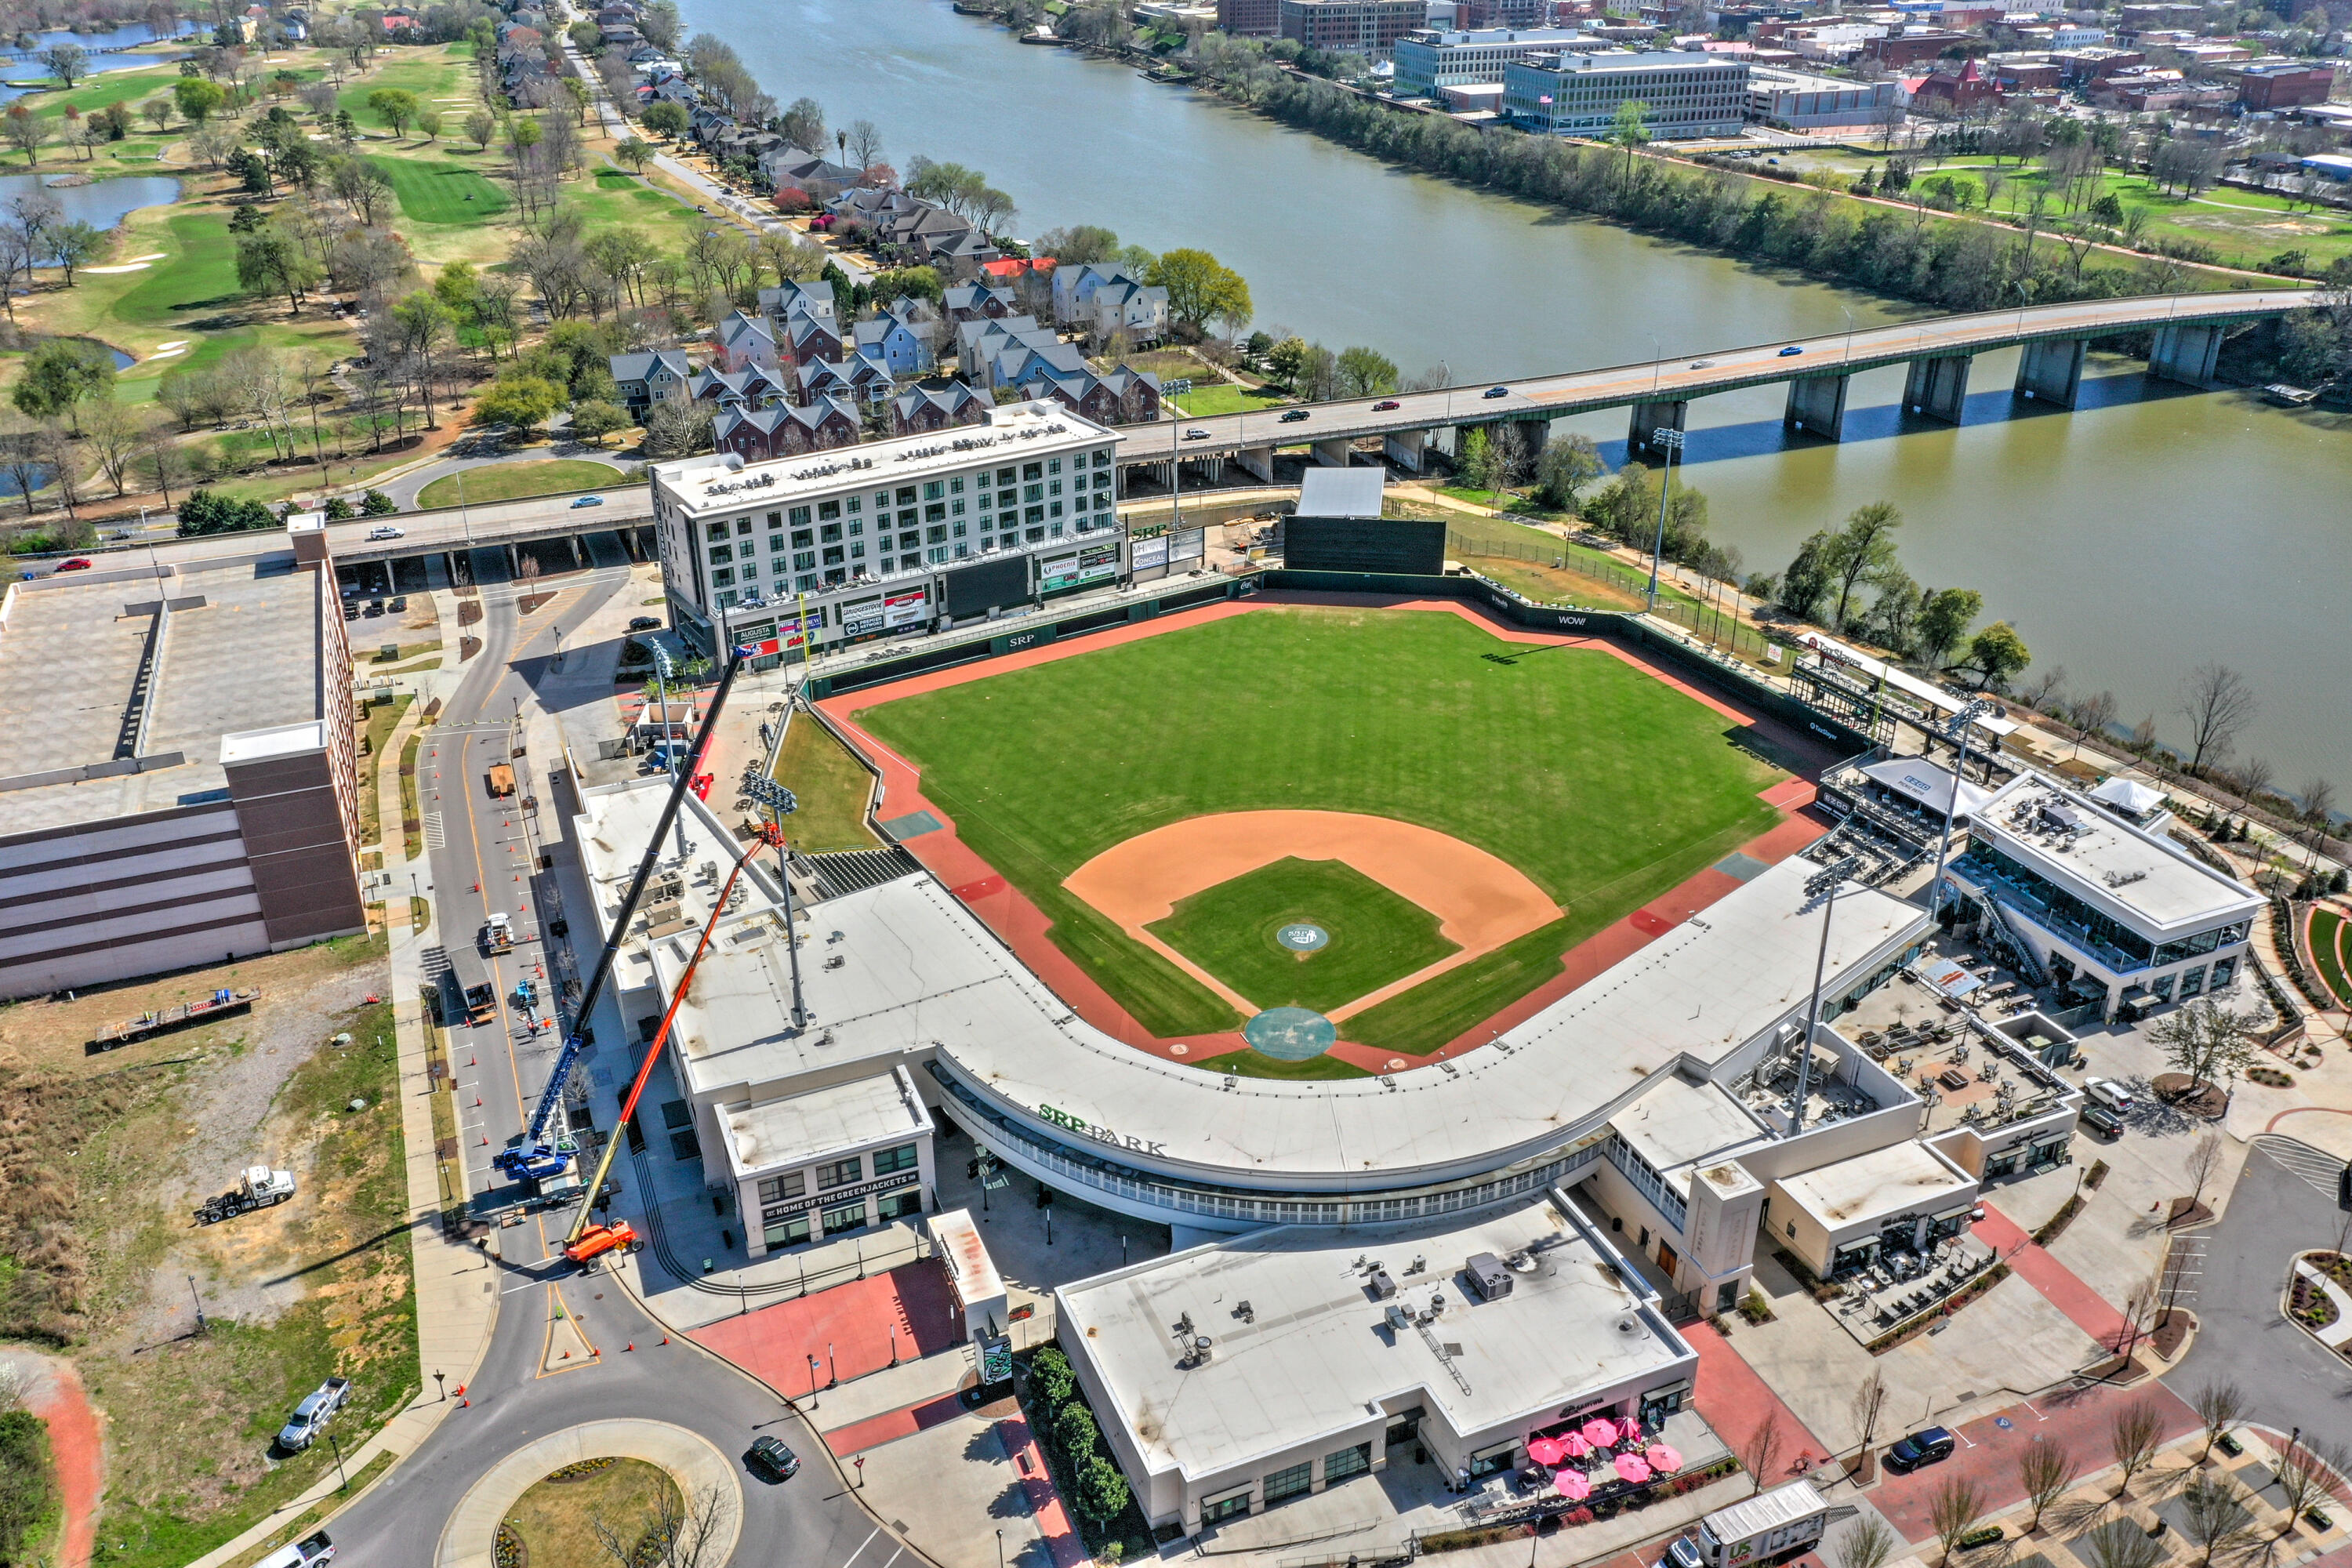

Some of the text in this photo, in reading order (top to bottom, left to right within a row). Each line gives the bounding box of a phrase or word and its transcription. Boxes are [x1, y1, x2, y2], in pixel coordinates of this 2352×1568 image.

[1132, 524, 1167, 541] SRP
[1051, 561, 1076, 571] PHOENIX
[1134, 554, 1165, 568] CONCEAL
[843, 602, 882, 615] BRIDGESTONE
[859, 616, 882, 626] PREMIER
[1559, 615, 1586, 625] WOW!
[740, 627, 771, 638] AUGUSTA
[1010, 634, 1035, 647] SRP
[1819, 641, 1864, 669] TaxSlayer
[1815, 724, 1838, 740] TaxSlayer
[1824, 793, 1849, 812] EZGO
[1039, 1103, 1168, 1159] SRP PARK
[776, 1203, 804, 1216] HOME
[805, 1200, 815, 1208] OF
[818, 1194, 837, 1205] THE
[1728, 1553, 1750, 1566] FOODS
